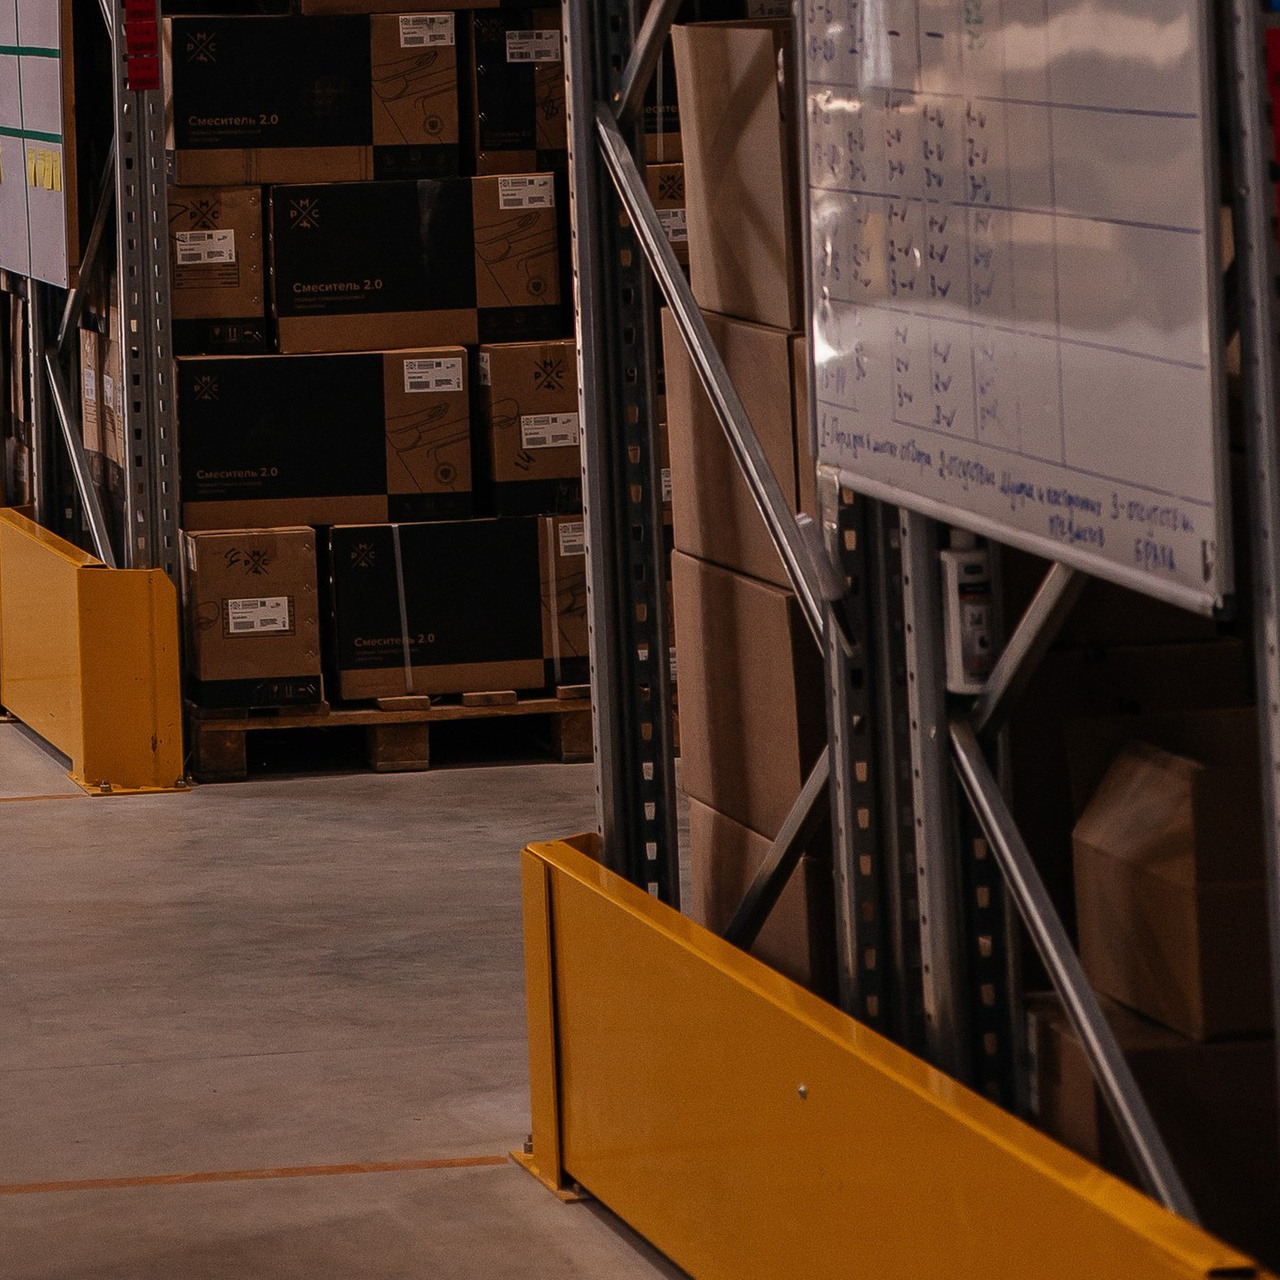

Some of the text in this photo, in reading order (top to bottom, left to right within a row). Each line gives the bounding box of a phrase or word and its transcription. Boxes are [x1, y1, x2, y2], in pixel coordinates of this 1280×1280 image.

[188, 114, 279, 126] Смеситель 2.0
[293, 278, 383, 292] Смеситель 2.0
[196, 466, 278, 479] Смеситель 2.0
[354, 633, 435, 648] Смеситеь 2.0
